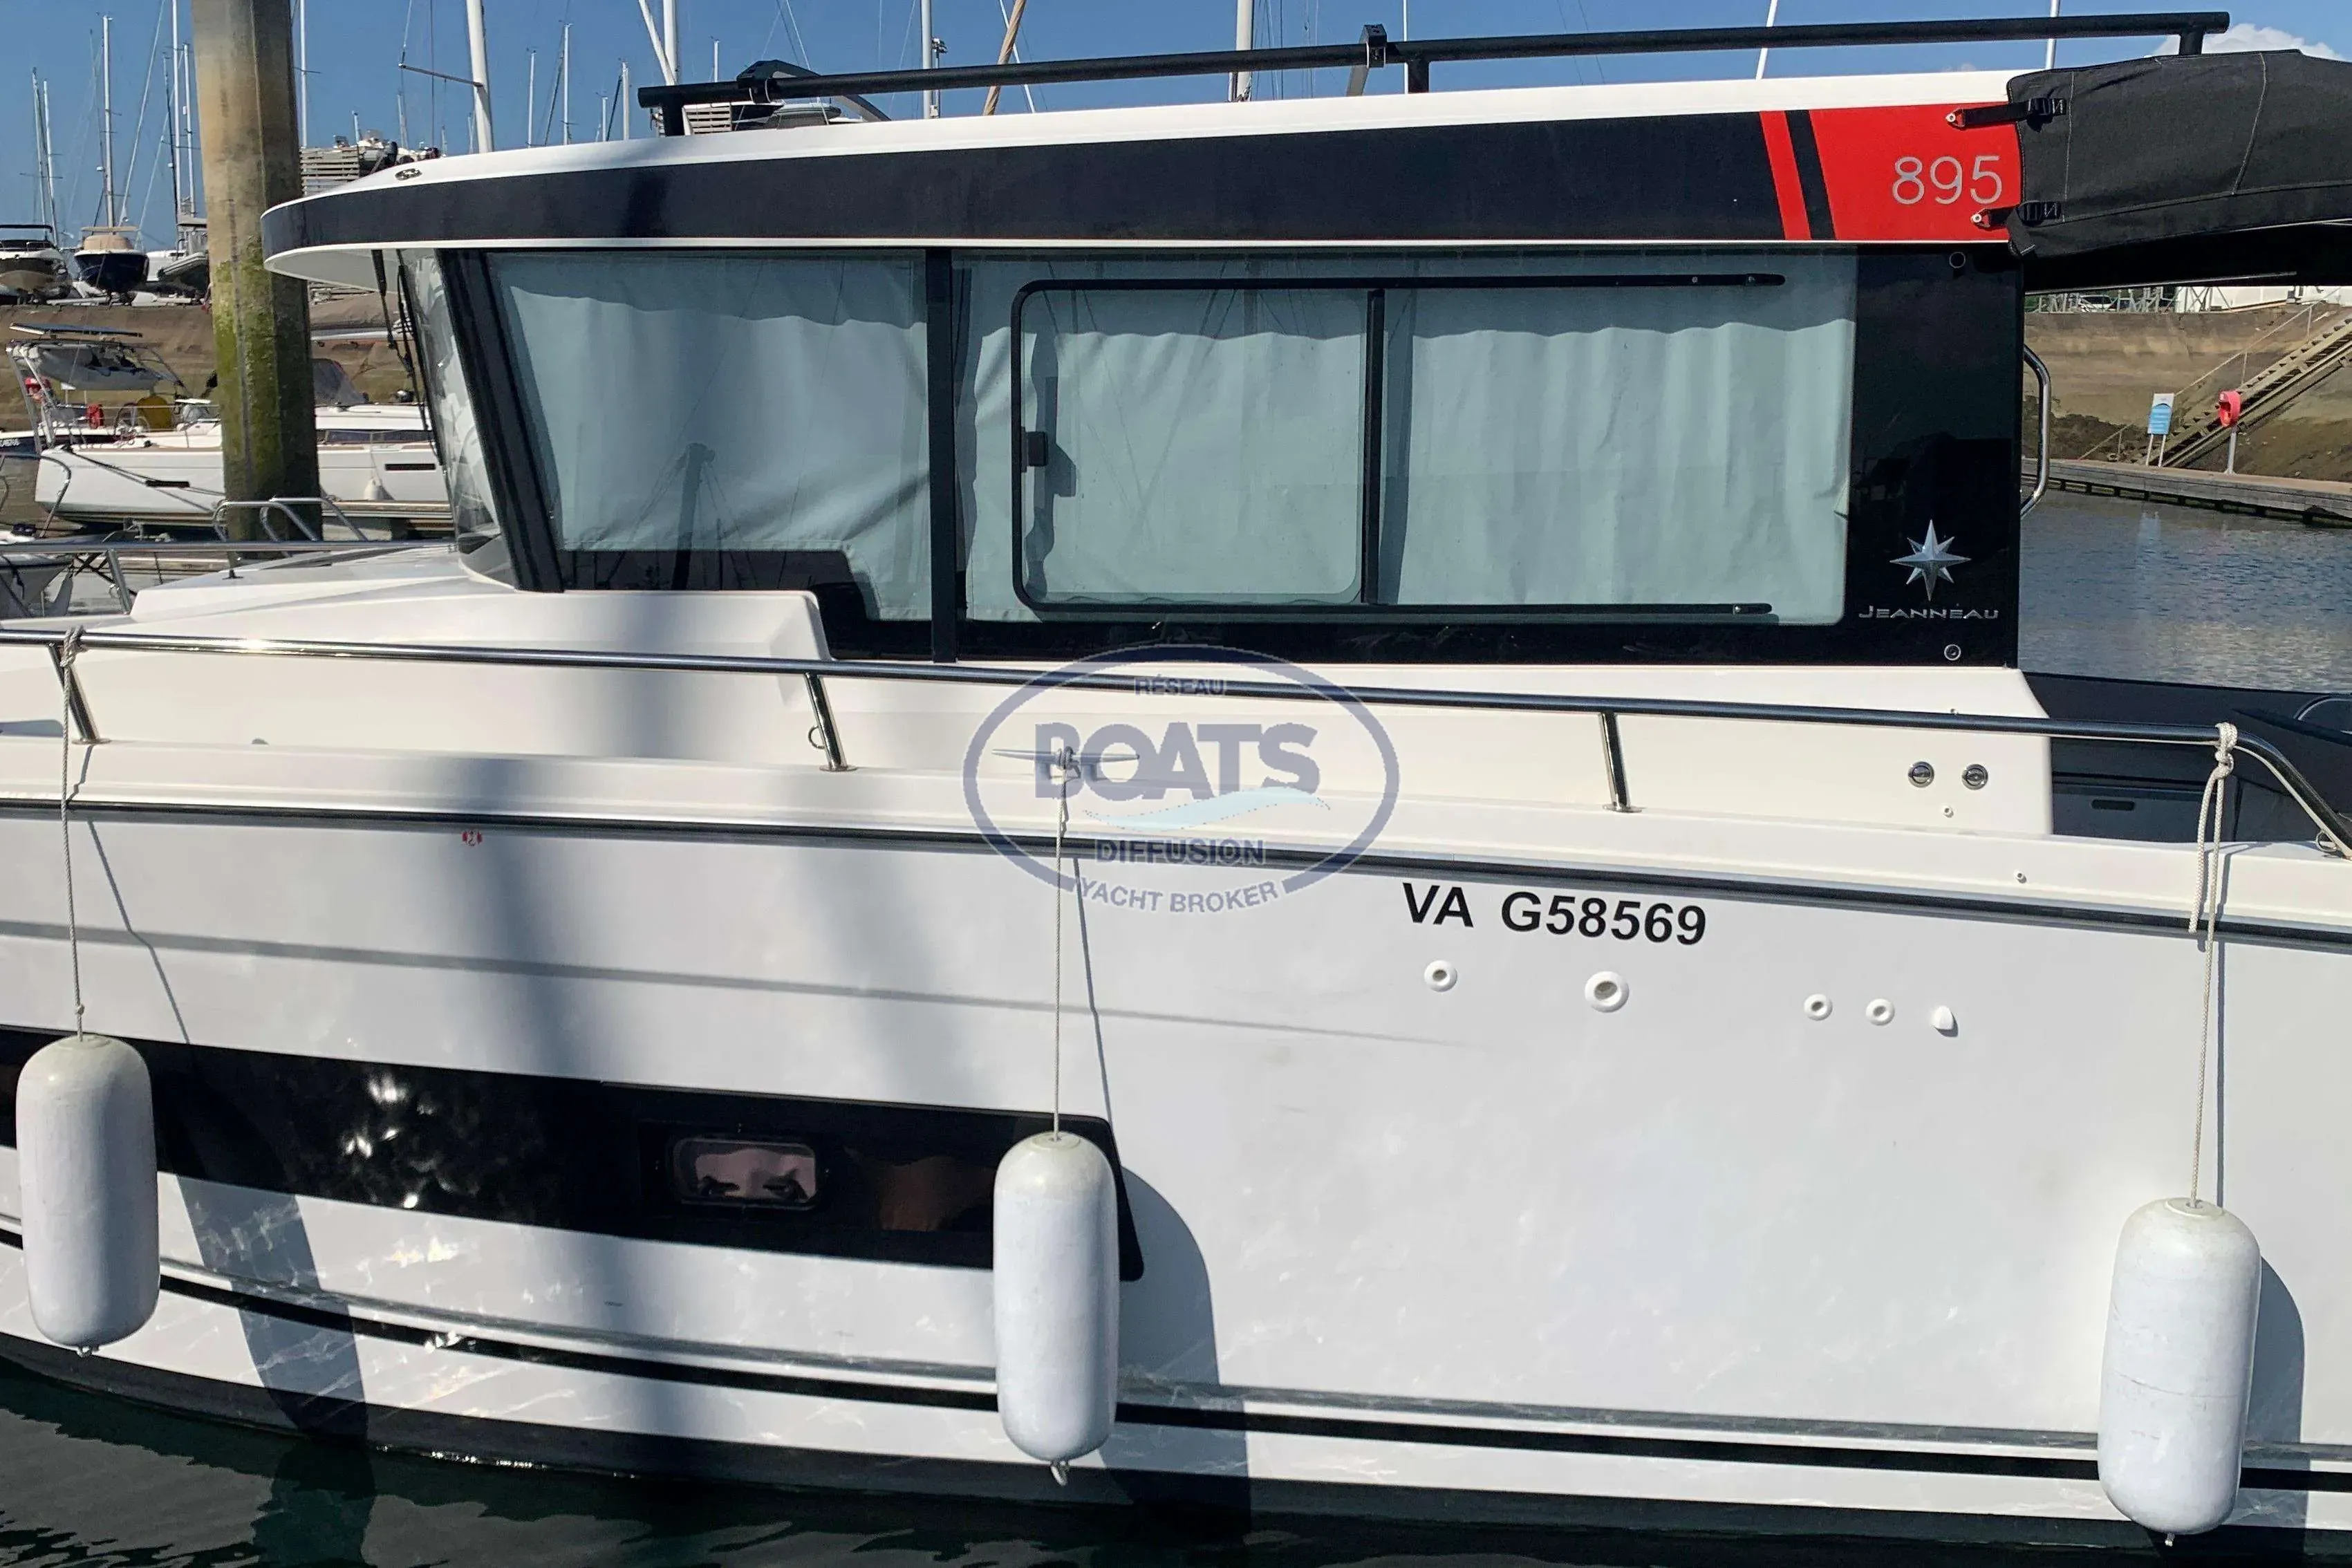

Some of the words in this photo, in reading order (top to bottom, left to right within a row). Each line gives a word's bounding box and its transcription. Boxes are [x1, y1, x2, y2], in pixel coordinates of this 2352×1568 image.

[1892, 155, 2003, 205] 895
[1858, 605, 1999, 619] JEANNEAU
[1401, 882, 1474, 928] VA
[1501, 891, 1707, 946] G58569
